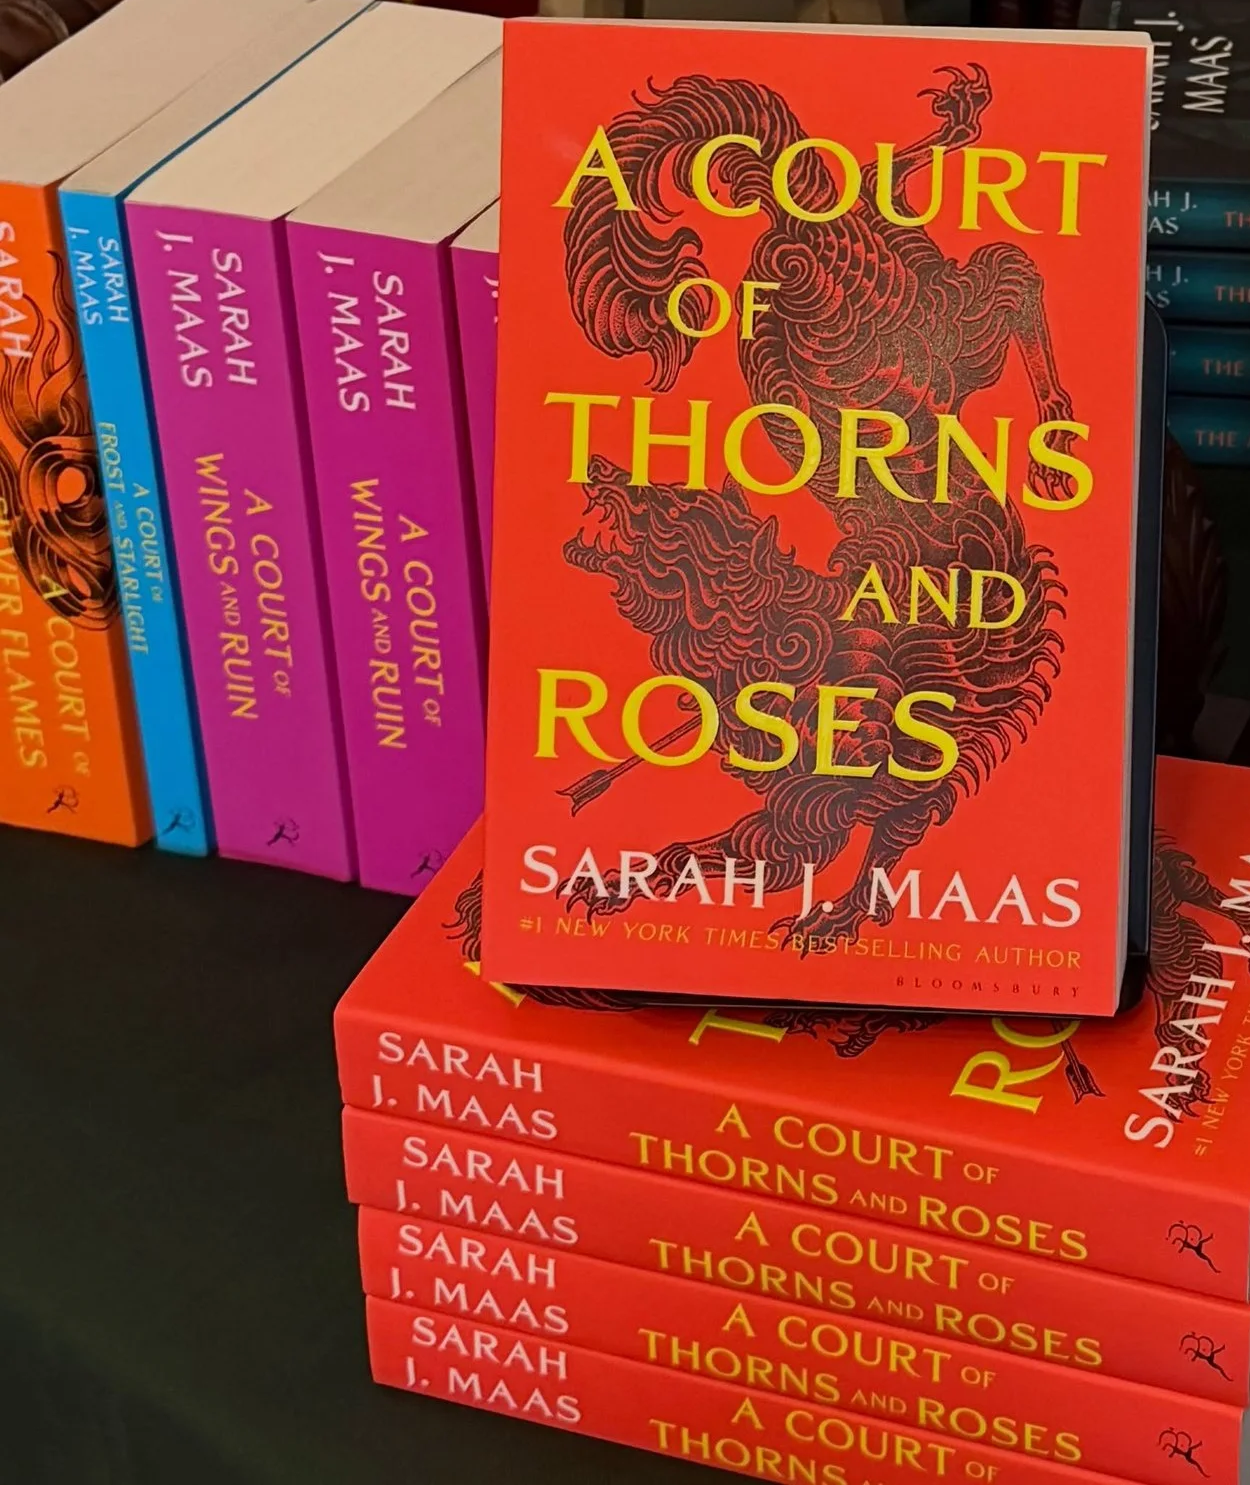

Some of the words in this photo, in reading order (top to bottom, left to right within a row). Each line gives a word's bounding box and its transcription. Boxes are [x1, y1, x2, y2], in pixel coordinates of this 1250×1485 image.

[1134, 10, 1184, 31] J.
[1182, 36, 1233, 114] MAAS
[551, 124, 640, 211] A
[691, 134, 1108, 236] COURT
[68, 226, 90, 239] J.
[154, 229, 194, 252] J.
[317, 250, 355, 274] J.
[74, 250, 103, 325] MAAS
[98, 236, 130, 323] SARAH
[211, 248, 258, 385] SARAH
[667, 277, 781, 341] OF
[166, 269, 214, 389] MAAS
[327, 291, 371, 413] MAAS
[372, 271, 417, 410] SARAH
[132, 482, 150, 499] A
[544, 391, 1094, 512] THORNS
[100, 421, 126, 494] FROST
[116, 536, 149, 655] STARLIGHT
[194, 452, 239, 576] WINGS
[244, 488, 274, 516] A
[350, 477, 392, 603] WINGS
[399, 513, 429, 544] A
[135, 507, 164, 583] COURT
[40, 574, 70, 601] A
[220, 581, 242, 627] AND
[251, 533, 294, 668] COURT
[839, 562, 1027, 630] AND
[371, 607, 392, 654] AND
[403, 560, 445, 696] COURT
[48, 615, 91, 742] COURT
[219, 631, 260, 720] RUIN
[272, 670, 292, 699] OF
[369, 658, 408, 750] RUIN
[422, 698, 442, 729] OF
[533, 668, 961, 782] ROSES
[519, 844, 766, 910] SARAH
[797, 862, 836, 920] J.
[866, 867, 1082, 929] MAAS
[519, 917, 544, 935] #1
[555, 917, 614, 939] NEW
[621, 921, 691, 945] YORK
[705, 926, 782, 952] TIMES
[791, 934, 963, 963] BESTSELLING
[977, 946, 1082, 971] AUTHOR
[896, 976, 1081, 998] BLOOMSBURY
[377, 1031, 544, 1093] SARAH
[1124, 970, 1236, 1149] SARAH
[372, 1075, 397, 1108] J.
[417, 1083, 558, 1141] MAAS
[715, 1102, 751, 1140] A
[773, 1115, 954, 1181] COURT
[963, 1162, 1000, 1186] OF
[403, 1136, 565, 1200] SARAH
[629, 1131, 839, 1205] THORNS
[850, 1189, 909, 1215] AND
[918, 1194, 1089, 1260] ROSES
[396, 1179, 420, 1212] J.
[439, 1189, 579, 1245] MAAS
[734, 1211, 769, 1247] A
[791, 1223, 969, 1290] COURT
[978, 1272, 1015, 1296] OF
[648, 1237, 857, 1310] THORNS
[866, 1296, 925, 1322] AND
[935, 1302, 1104, 1367] ROSES
